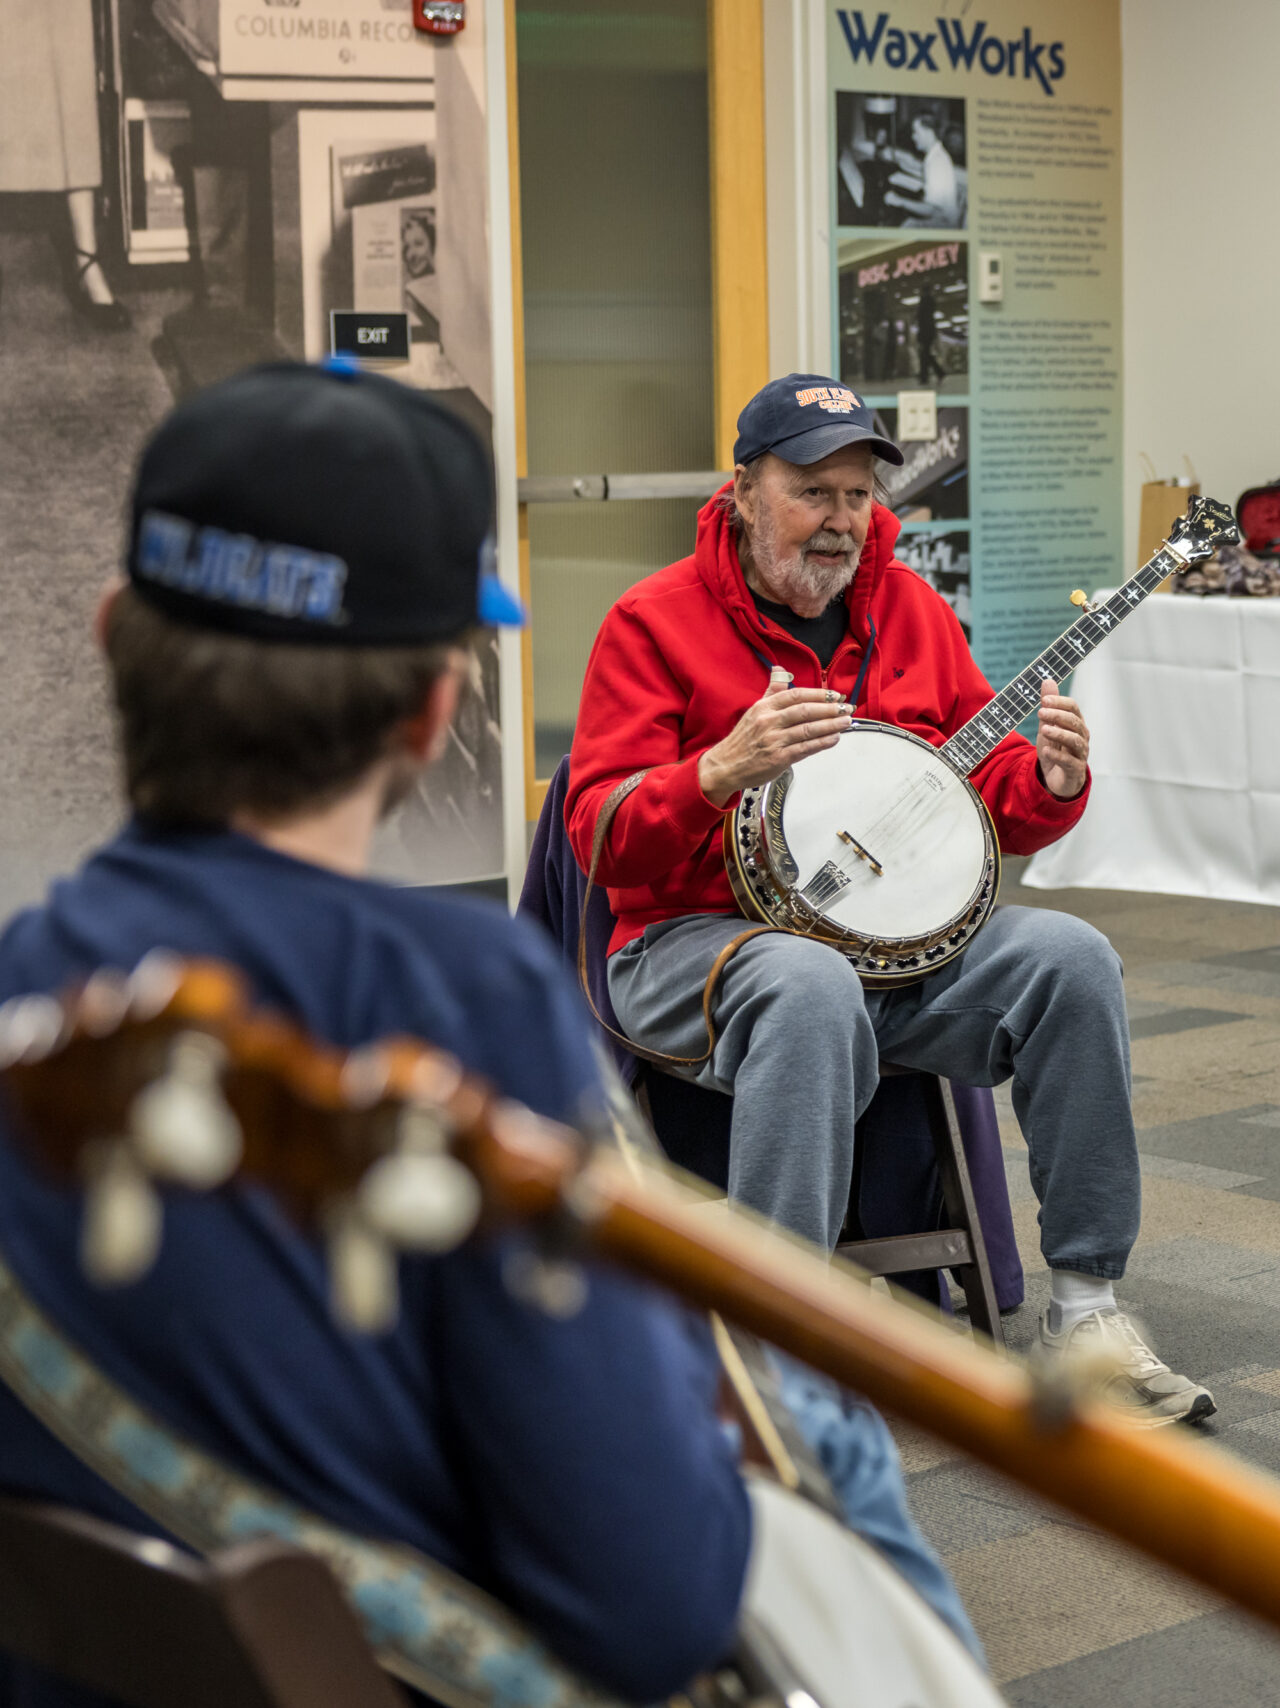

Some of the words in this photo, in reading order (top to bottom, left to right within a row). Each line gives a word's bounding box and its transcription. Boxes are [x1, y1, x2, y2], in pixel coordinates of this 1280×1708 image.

[235, 14, 352, 41] COLUMBIA
[858, 260, 889, 288] DISC
[892, 242, 959, 279] JOCKEY
[357, 327, 389, 344] EXIT
[796, 387, 832, 407] SOUTH
